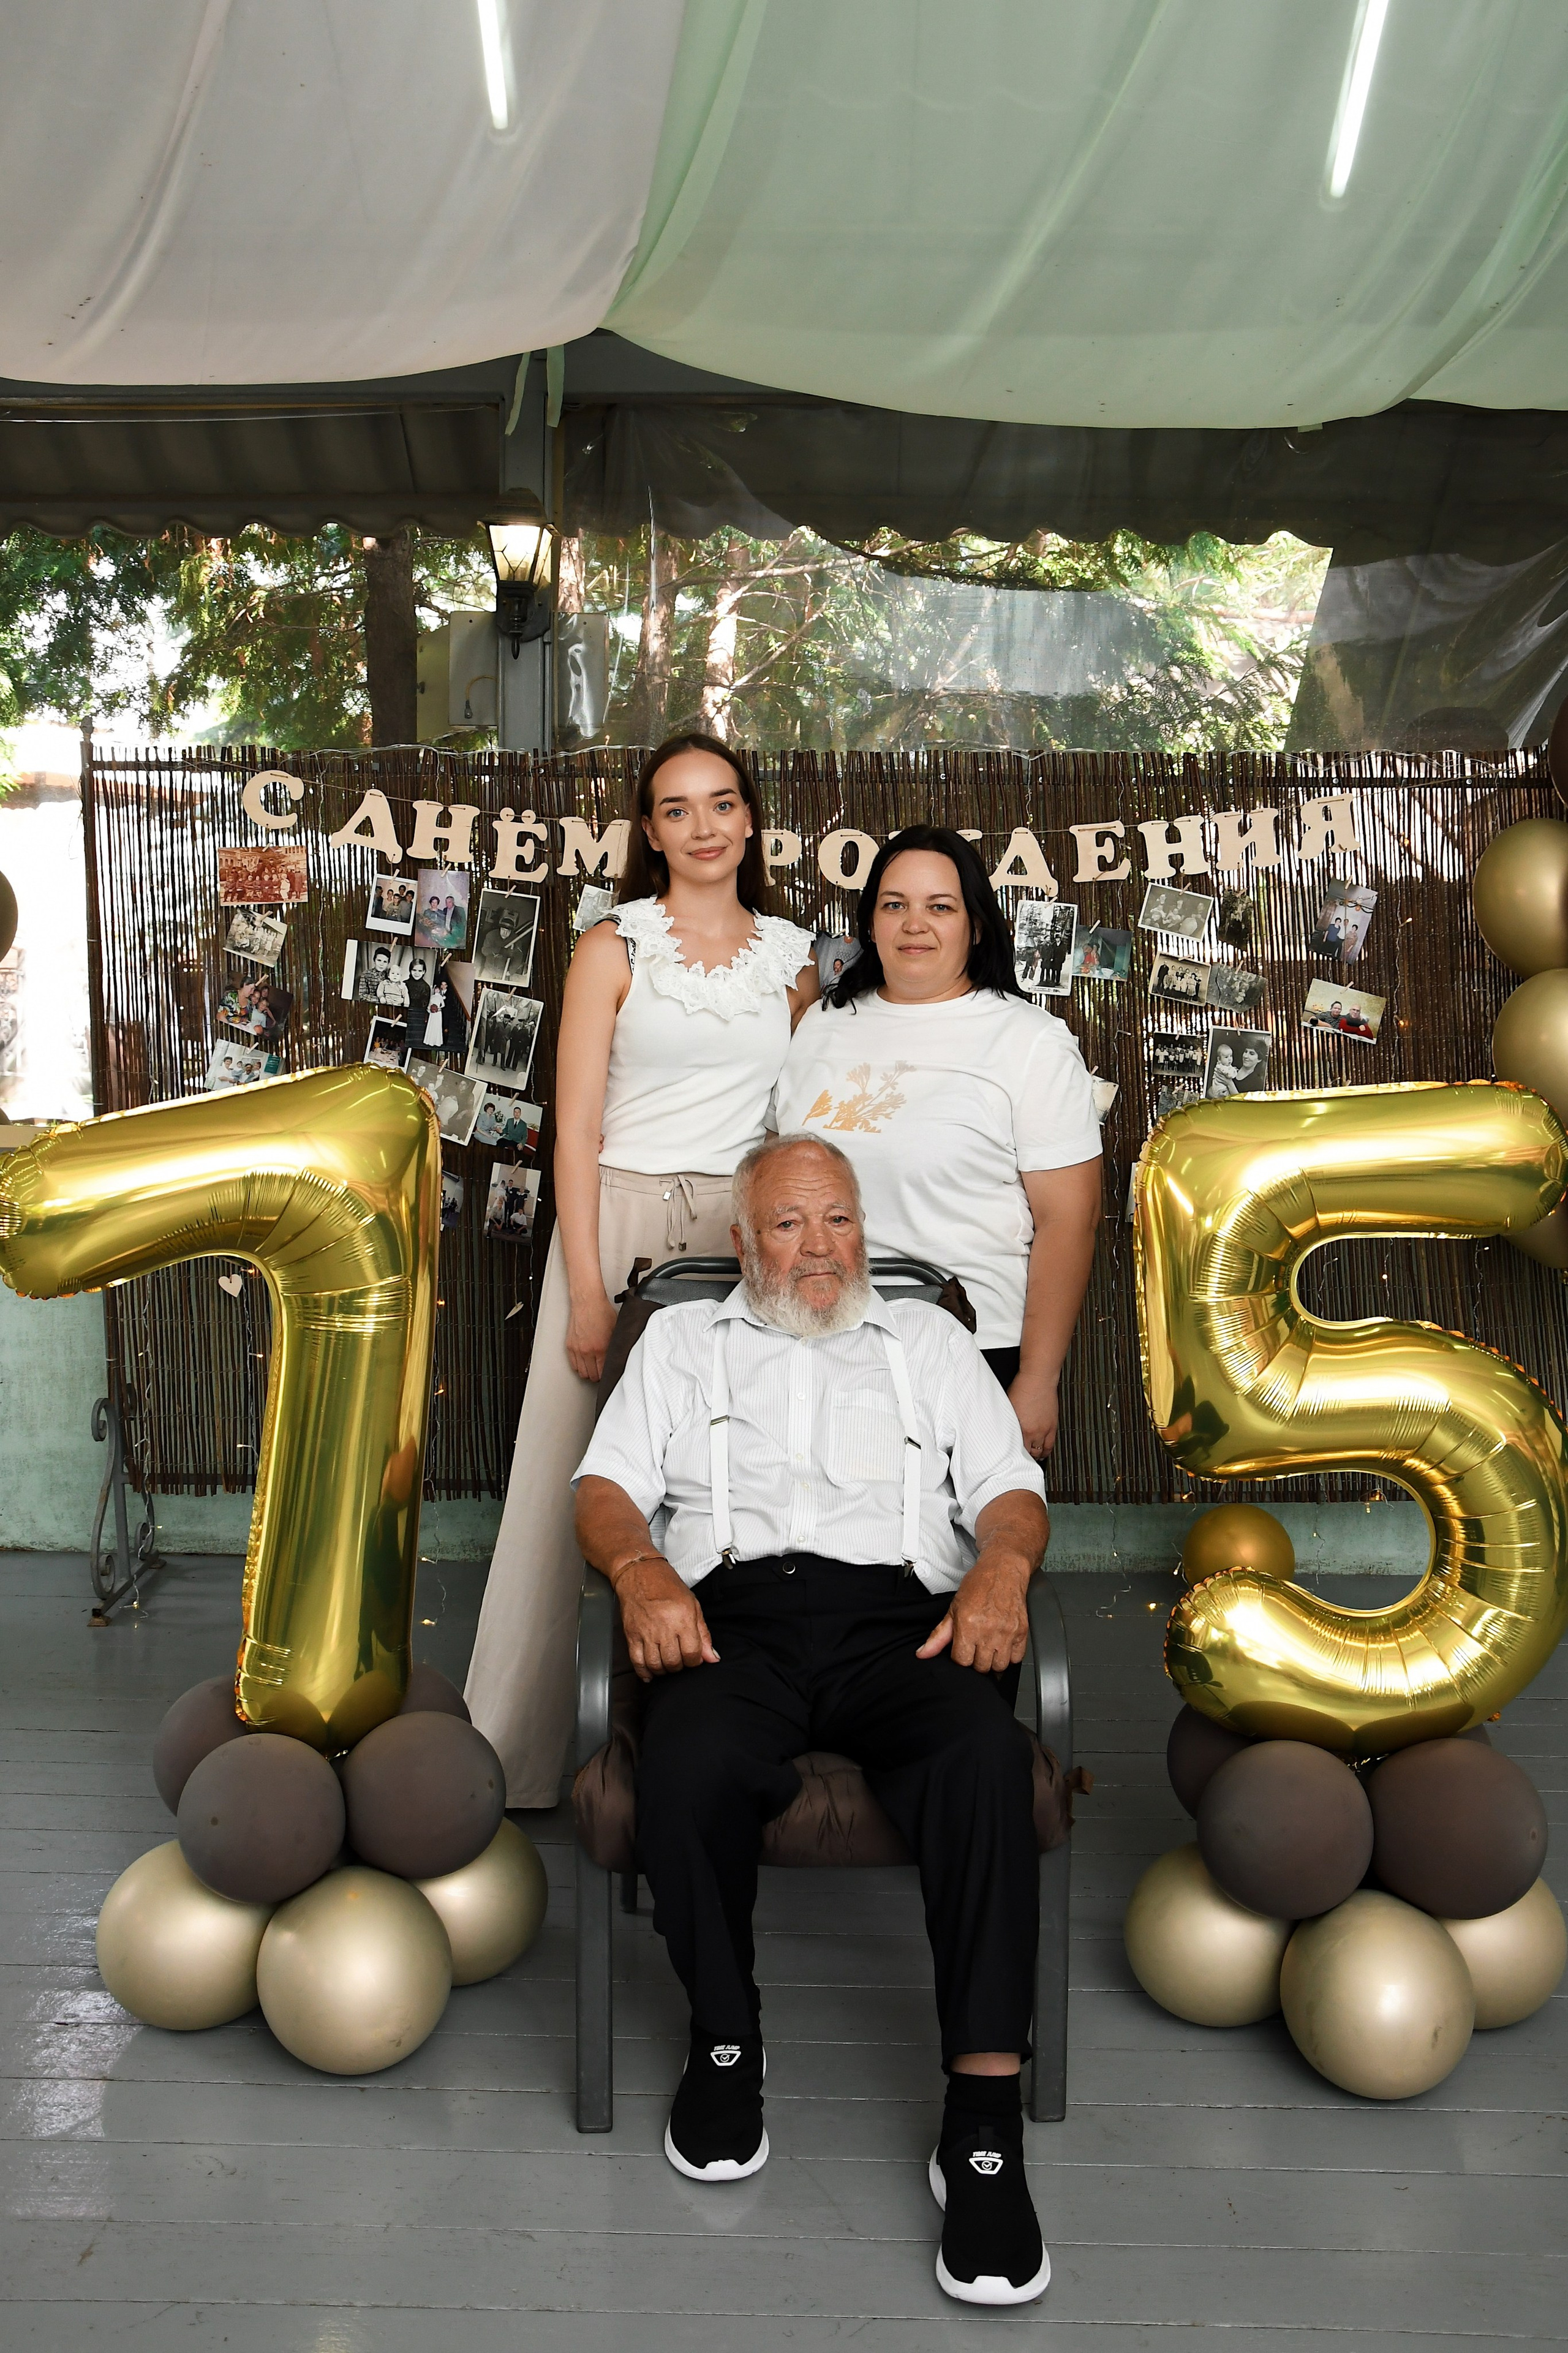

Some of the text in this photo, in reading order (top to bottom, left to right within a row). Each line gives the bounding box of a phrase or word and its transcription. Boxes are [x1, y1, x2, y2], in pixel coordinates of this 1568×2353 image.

[243, 770, 1361, 897] С ДНЁМ РОДЕНИЯ
[0, 1063, 1568, 1754] 7 5
